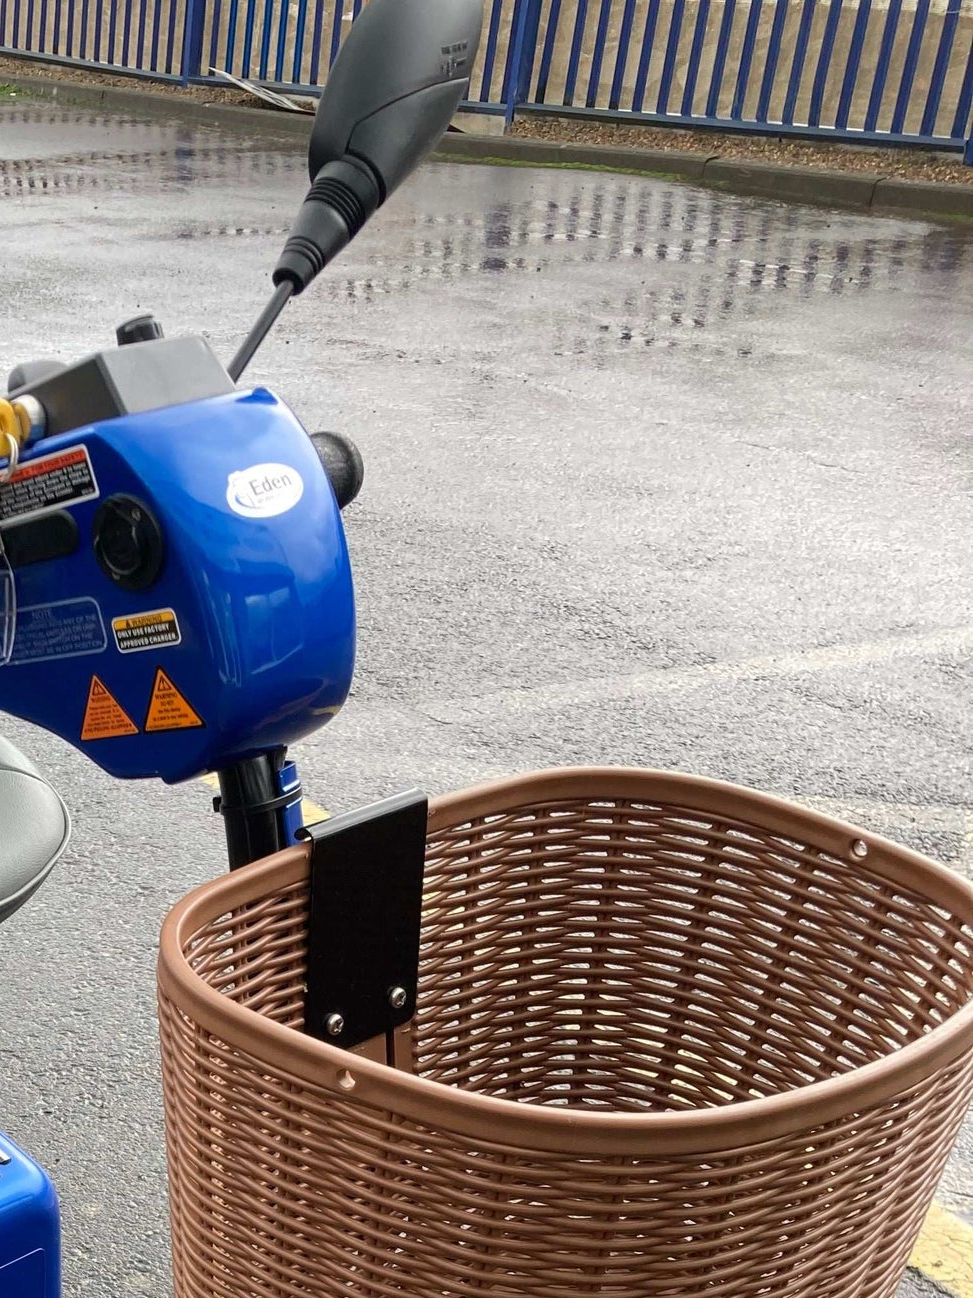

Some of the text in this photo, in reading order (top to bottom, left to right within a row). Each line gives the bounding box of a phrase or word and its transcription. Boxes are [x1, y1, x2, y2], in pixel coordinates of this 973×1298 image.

[248, 475, 292, 496] Eden
[117, 623, 170, 639] ONLY USE FACTORY
[120, 637, 148, 648] APPROVED
